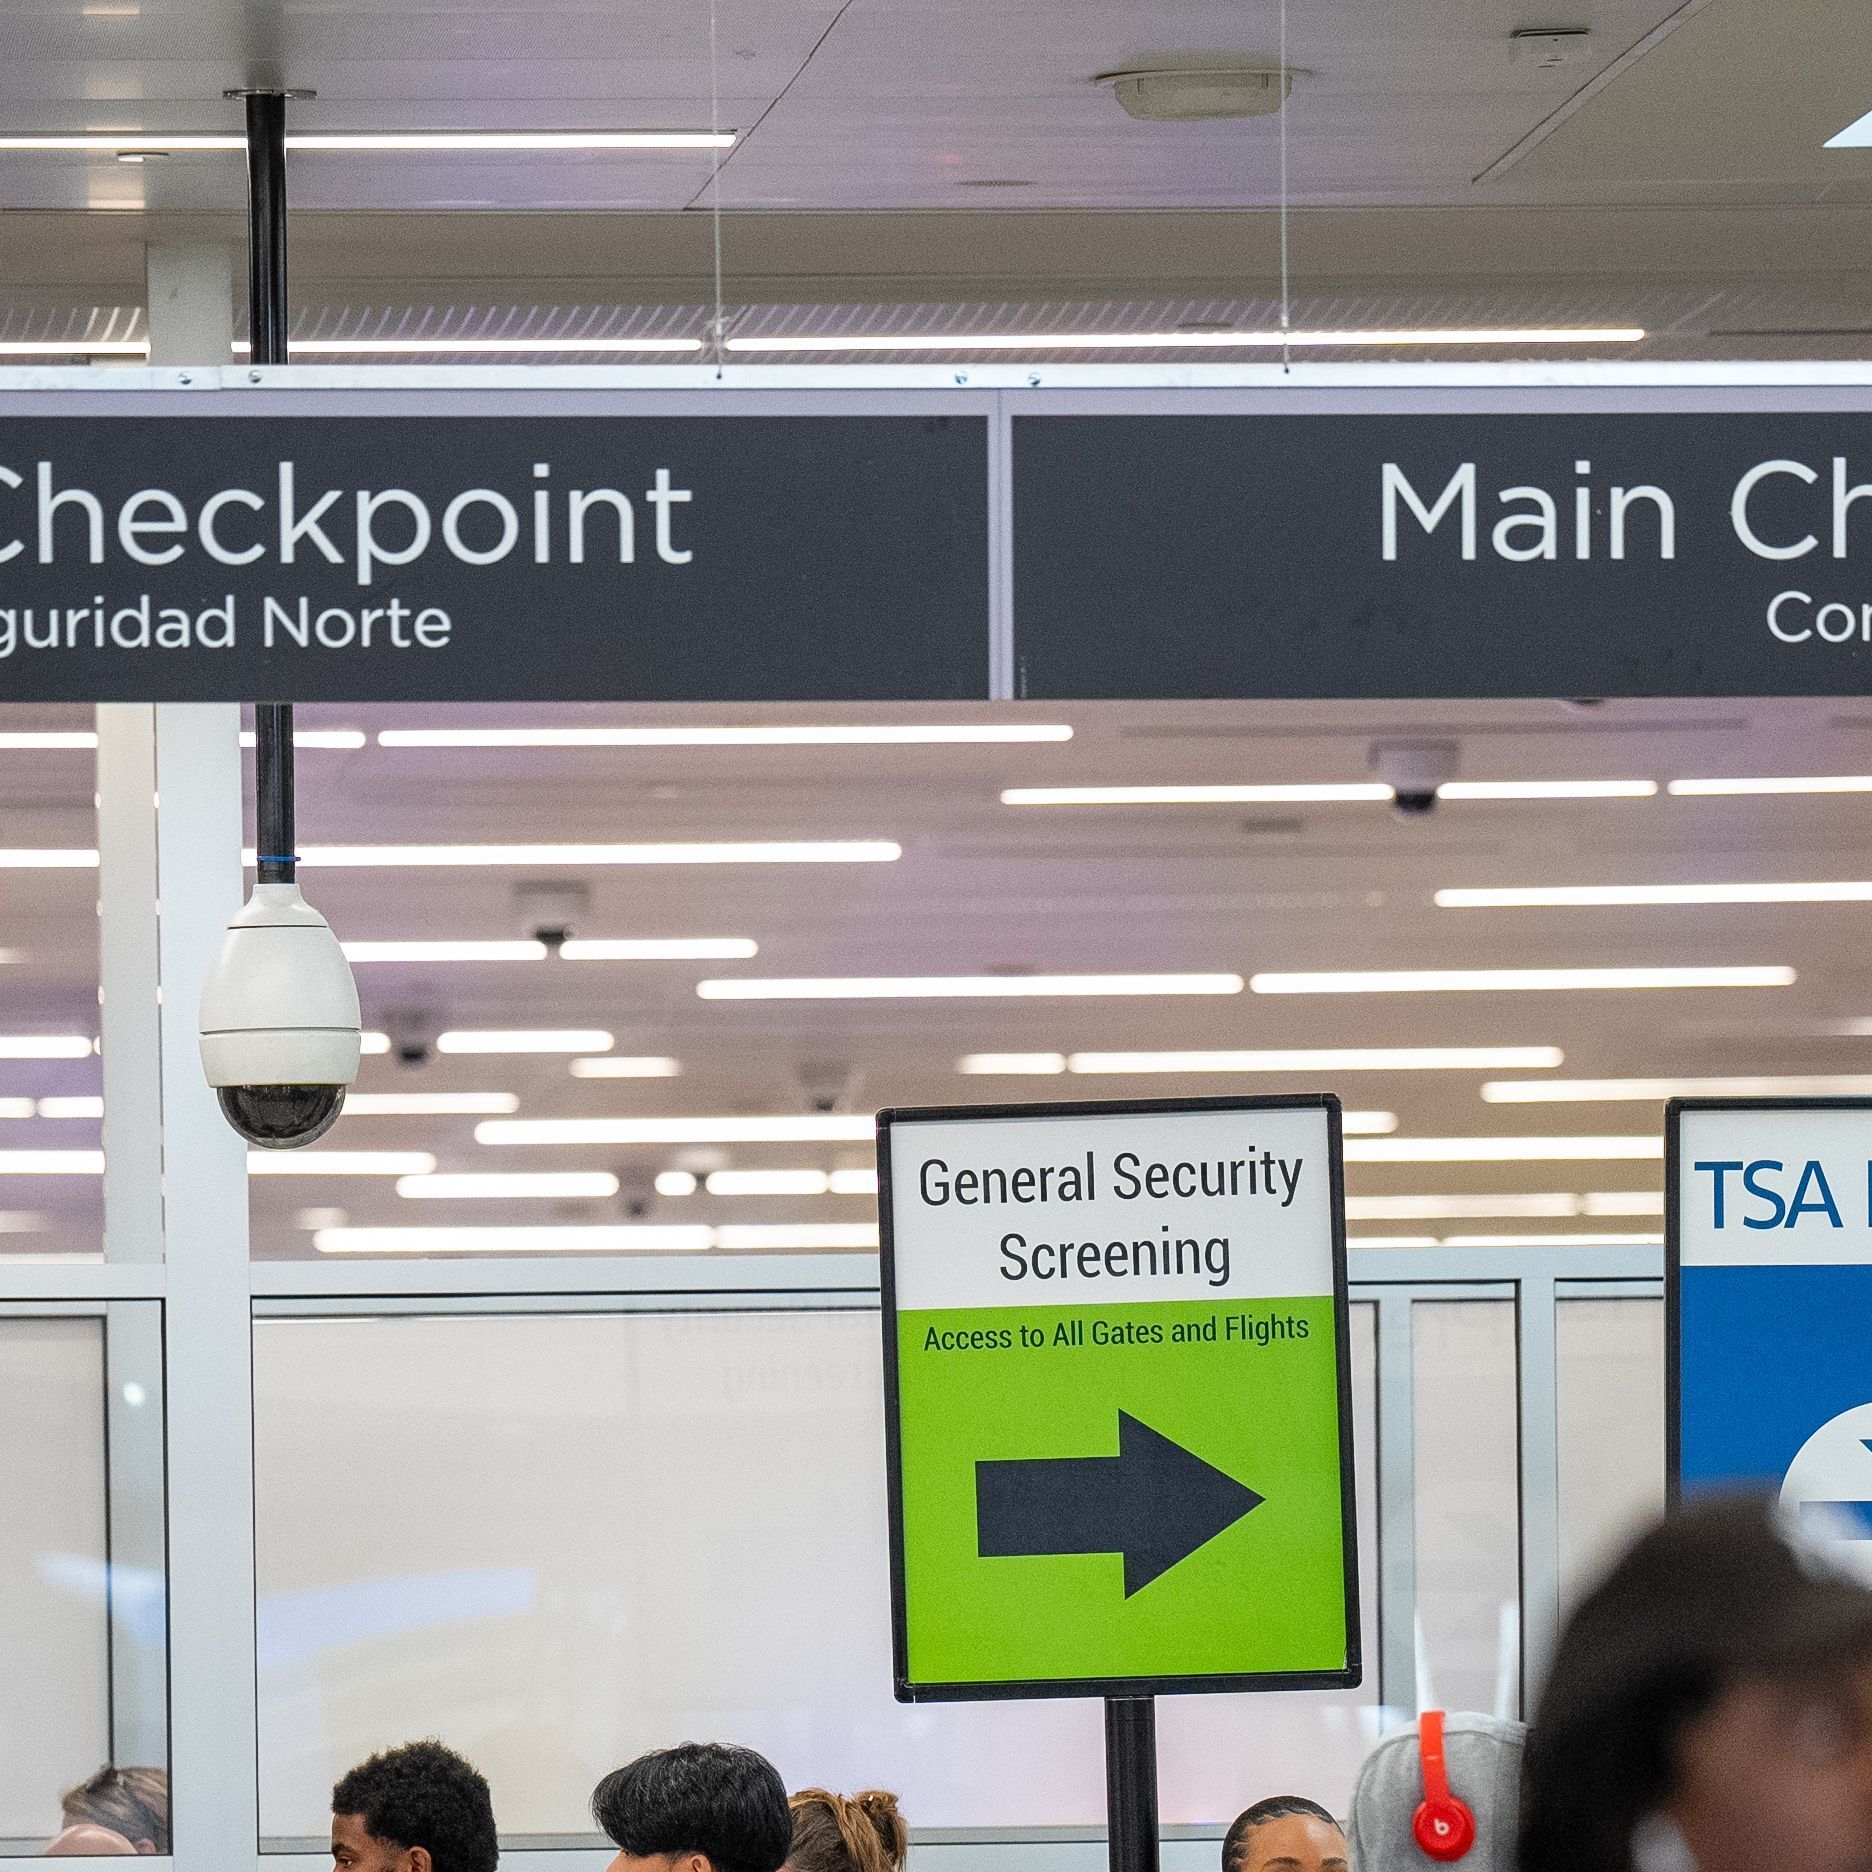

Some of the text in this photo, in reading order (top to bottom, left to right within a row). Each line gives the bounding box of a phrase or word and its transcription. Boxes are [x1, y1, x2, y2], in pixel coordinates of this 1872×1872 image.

[1381, 459, 1675, 562] Main
[263, 596, 452, 649] Norte
[920, 1145, 1303, 1208] General Security
[1693, 1159, 1844, 1230] TSA
[1000, 1225, 1231, 1288] Screening
[924, 1313, 1309, 1351] Access to All Gates and Flights
